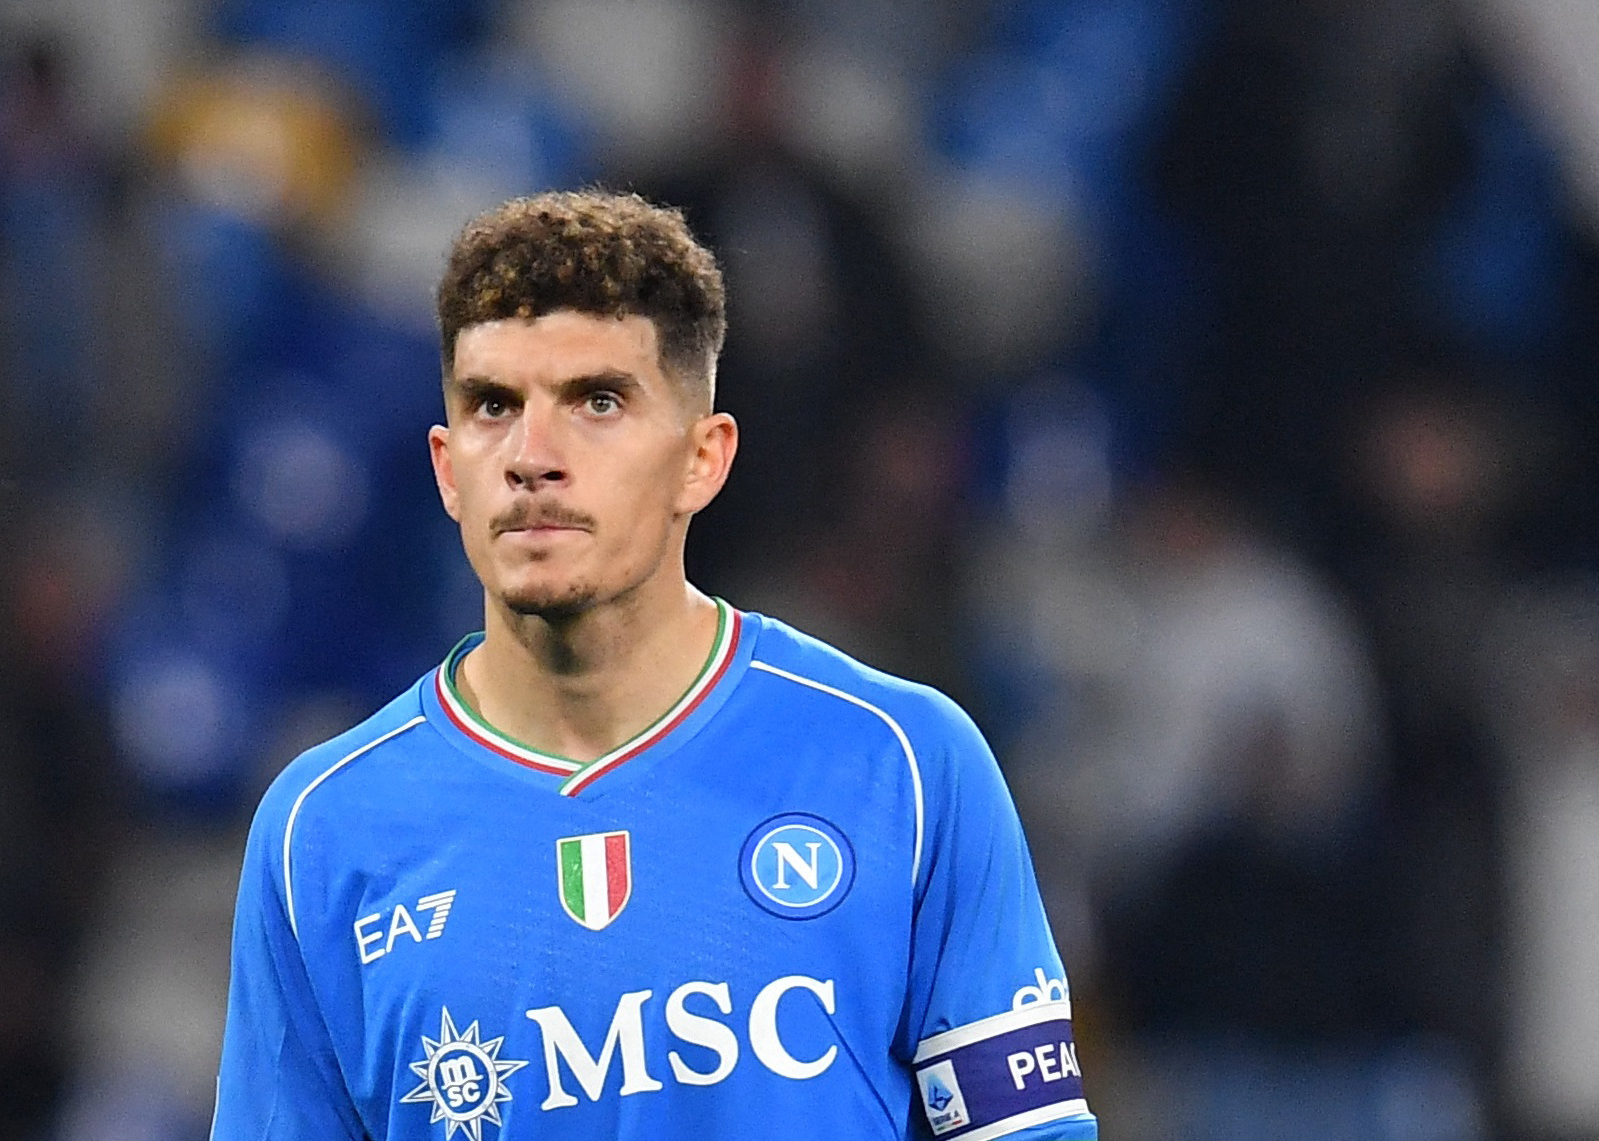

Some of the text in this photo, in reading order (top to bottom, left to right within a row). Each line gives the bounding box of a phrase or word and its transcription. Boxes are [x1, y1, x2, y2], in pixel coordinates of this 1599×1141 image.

[771, 842, 825, 892] N
[354, 890, 457, 965] EA7
[526, 975, 838, 1112] MSC
